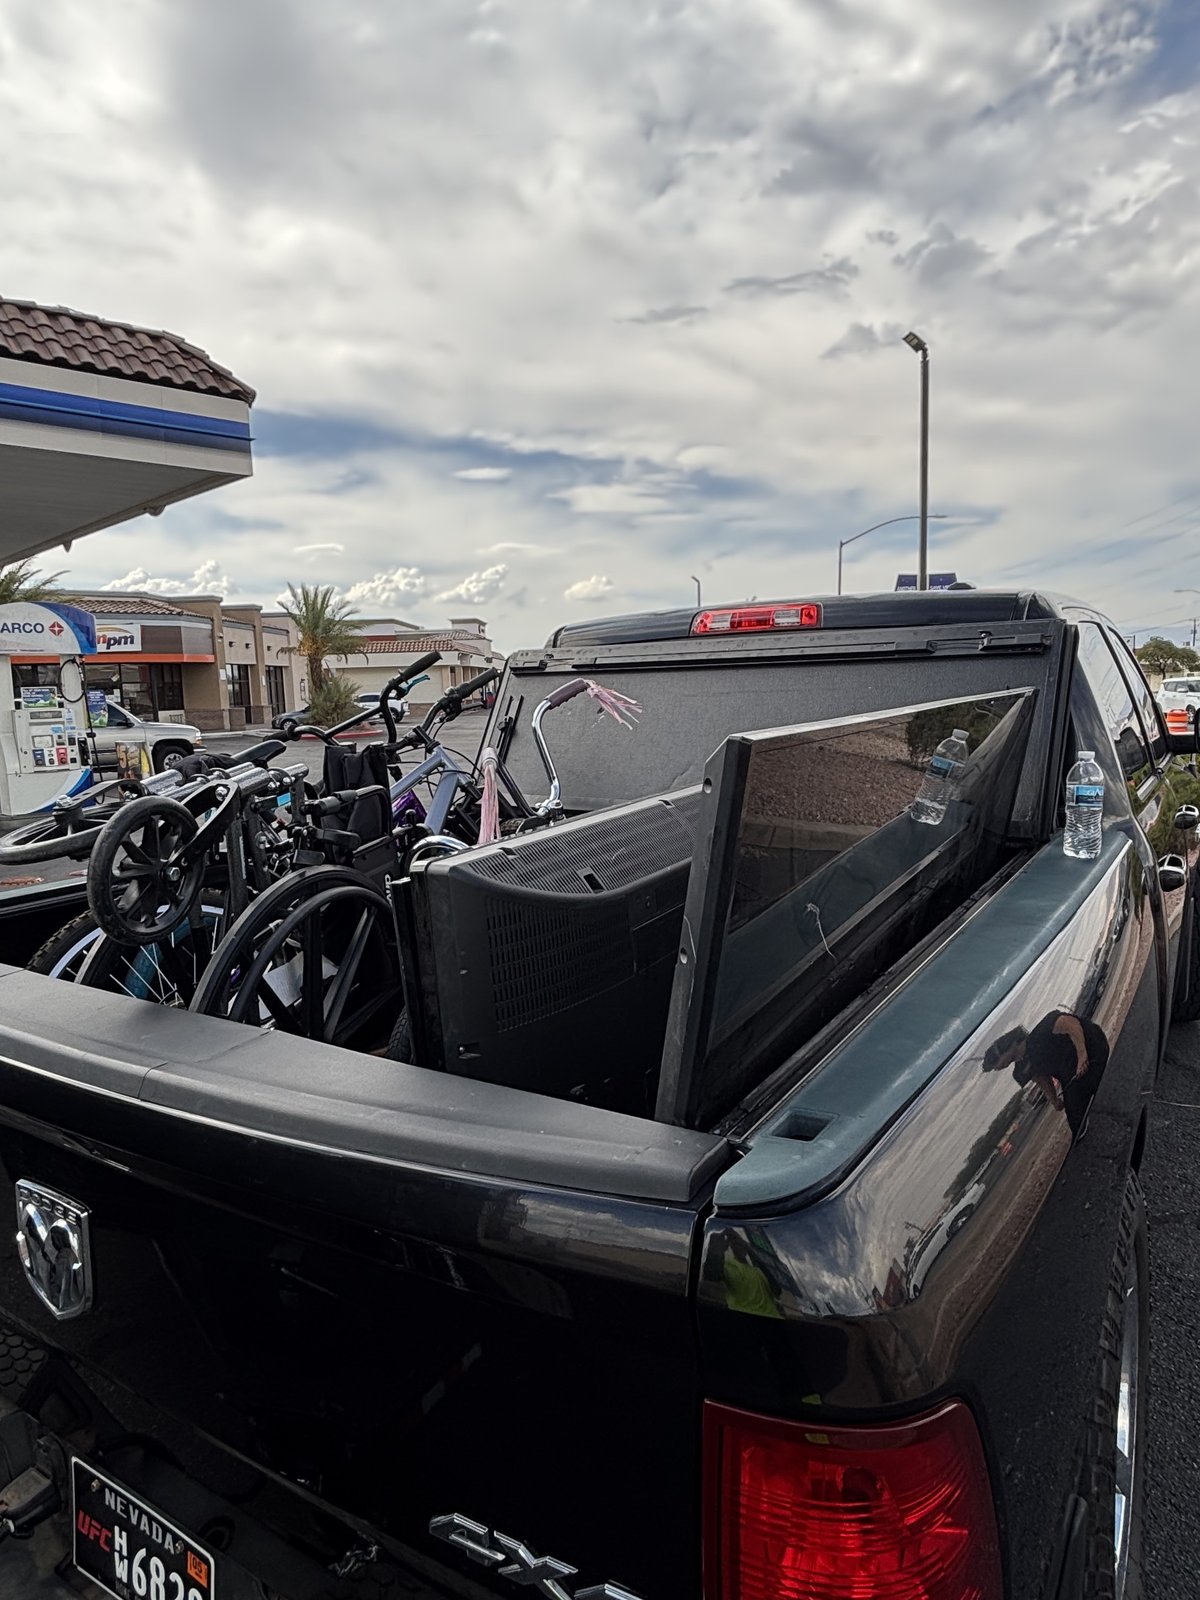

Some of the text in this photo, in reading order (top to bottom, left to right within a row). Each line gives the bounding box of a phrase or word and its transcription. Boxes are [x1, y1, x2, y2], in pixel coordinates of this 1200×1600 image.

[0, 622, 45, 634] ARCO
[20, 1189, 77, 1225] DODGE
[77, 1509, 112, 1552] UFC
[104, 1487, 175, 1555] NEVADA
[132, 1547, 204, 1600] 682
